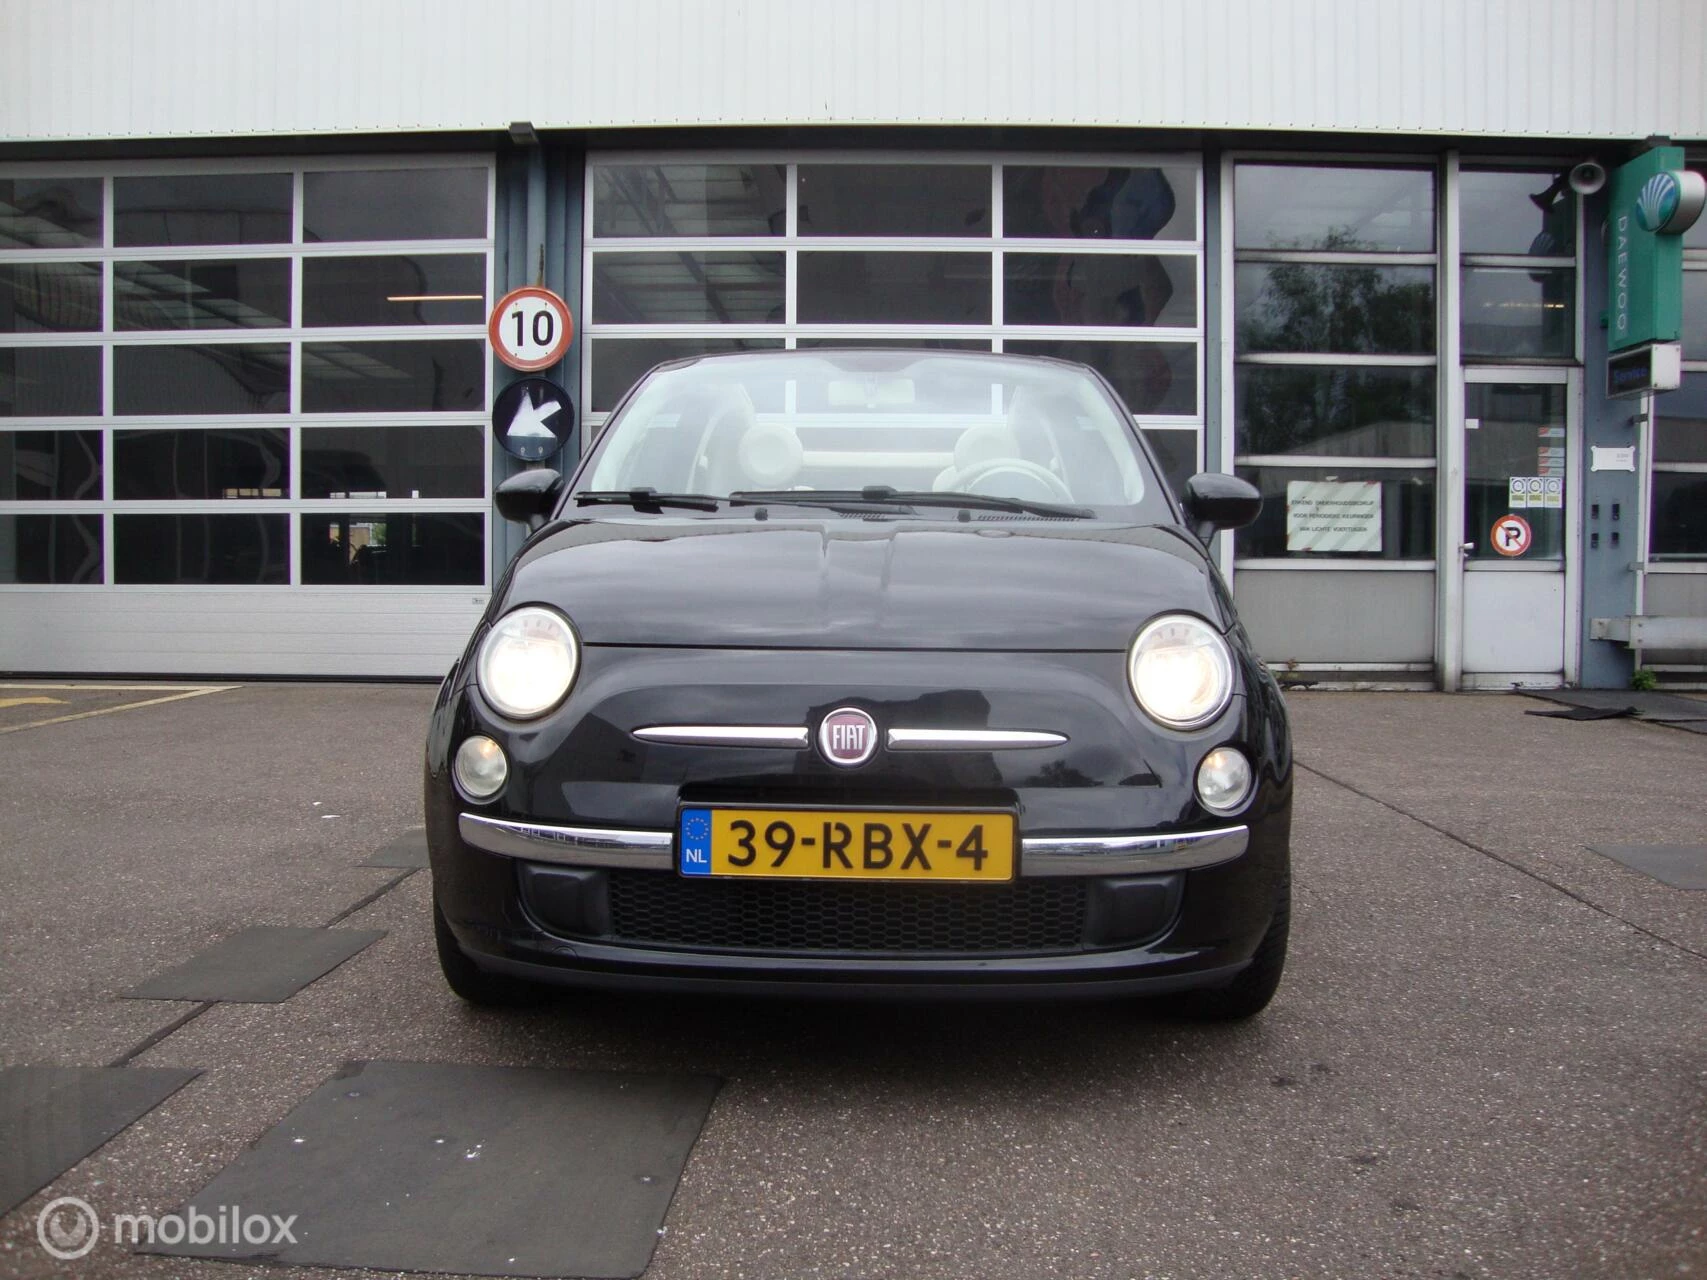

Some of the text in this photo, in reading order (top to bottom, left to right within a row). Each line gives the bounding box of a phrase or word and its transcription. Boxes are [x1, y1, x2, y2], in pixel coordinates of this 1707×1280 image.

[1616, 215, 1628, 331] DAEWOO
[511, 310, 554, 347] 10
[832, 724, 866, 751] FIAT
[686, 848, 708, 864] NL
[727, 819, 989, 871] 39-RBX-4
